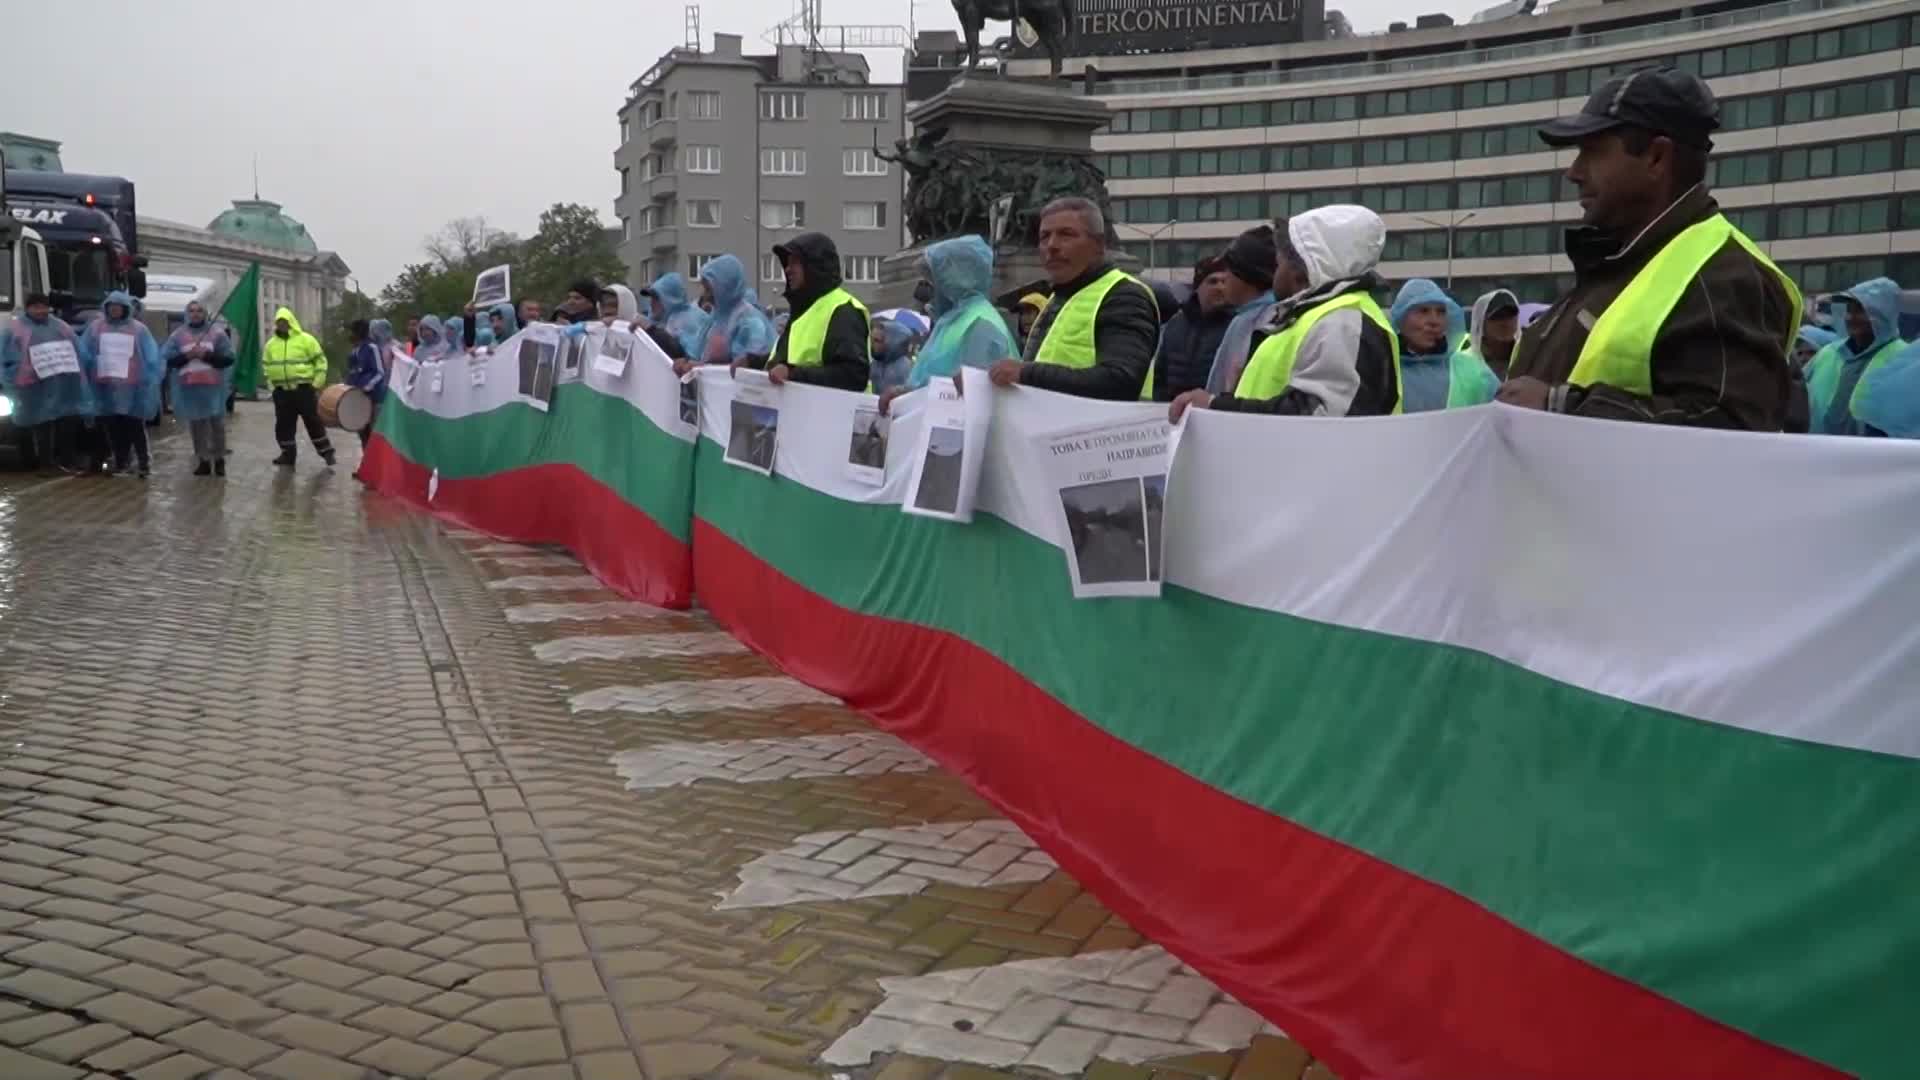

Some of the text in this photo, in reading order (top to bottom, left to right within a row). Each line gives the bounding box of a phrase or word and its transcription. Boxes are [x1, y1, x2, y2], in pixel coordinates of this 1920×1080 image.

[1063, 3, 1289, 36] TERCONTINENTAL
[12, 208, 68, 224] ELAX
[1050, 441, 1083, 456] ТОВА
